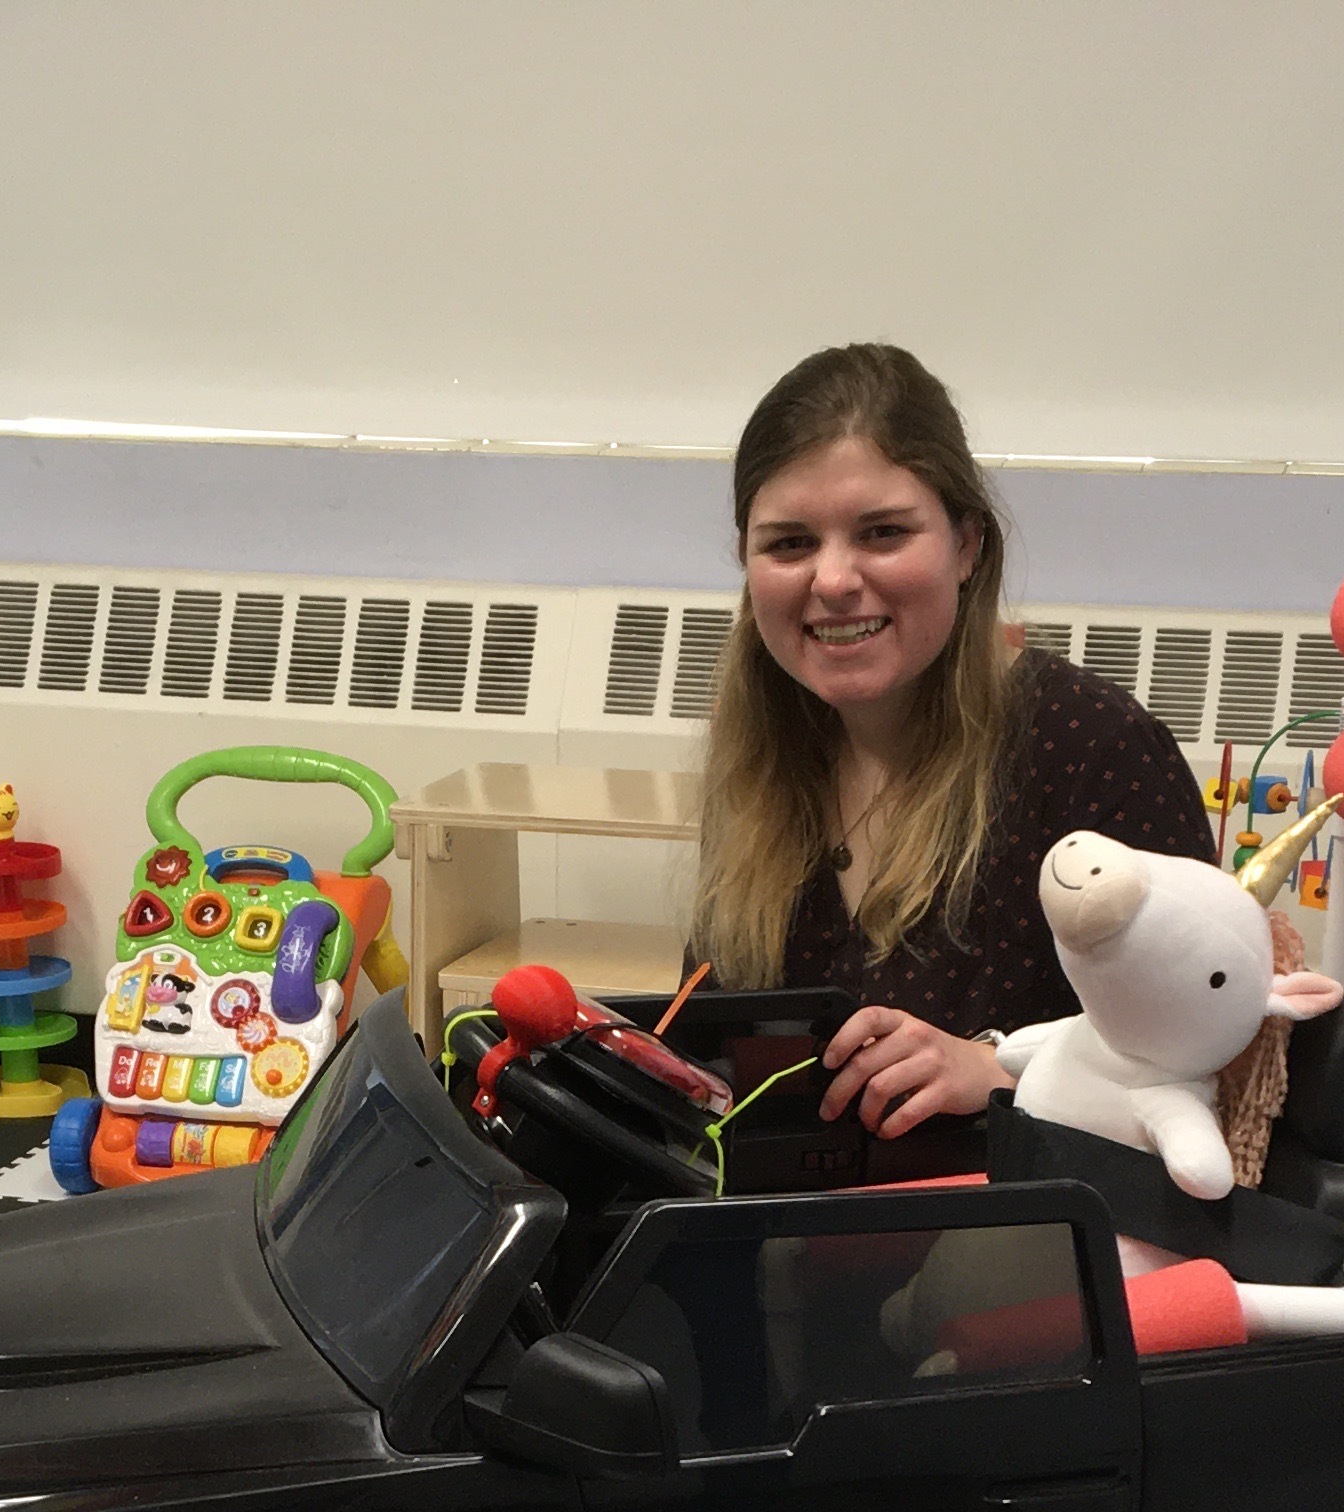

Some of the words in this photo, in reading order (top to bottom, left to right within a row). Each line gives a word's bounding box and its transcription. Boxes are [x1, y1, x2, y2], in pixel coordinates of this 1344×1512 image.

[143, 907, 154, 923] 1
[202, 907, 215, 922] 2
[254, 922, 267, 937] 3
